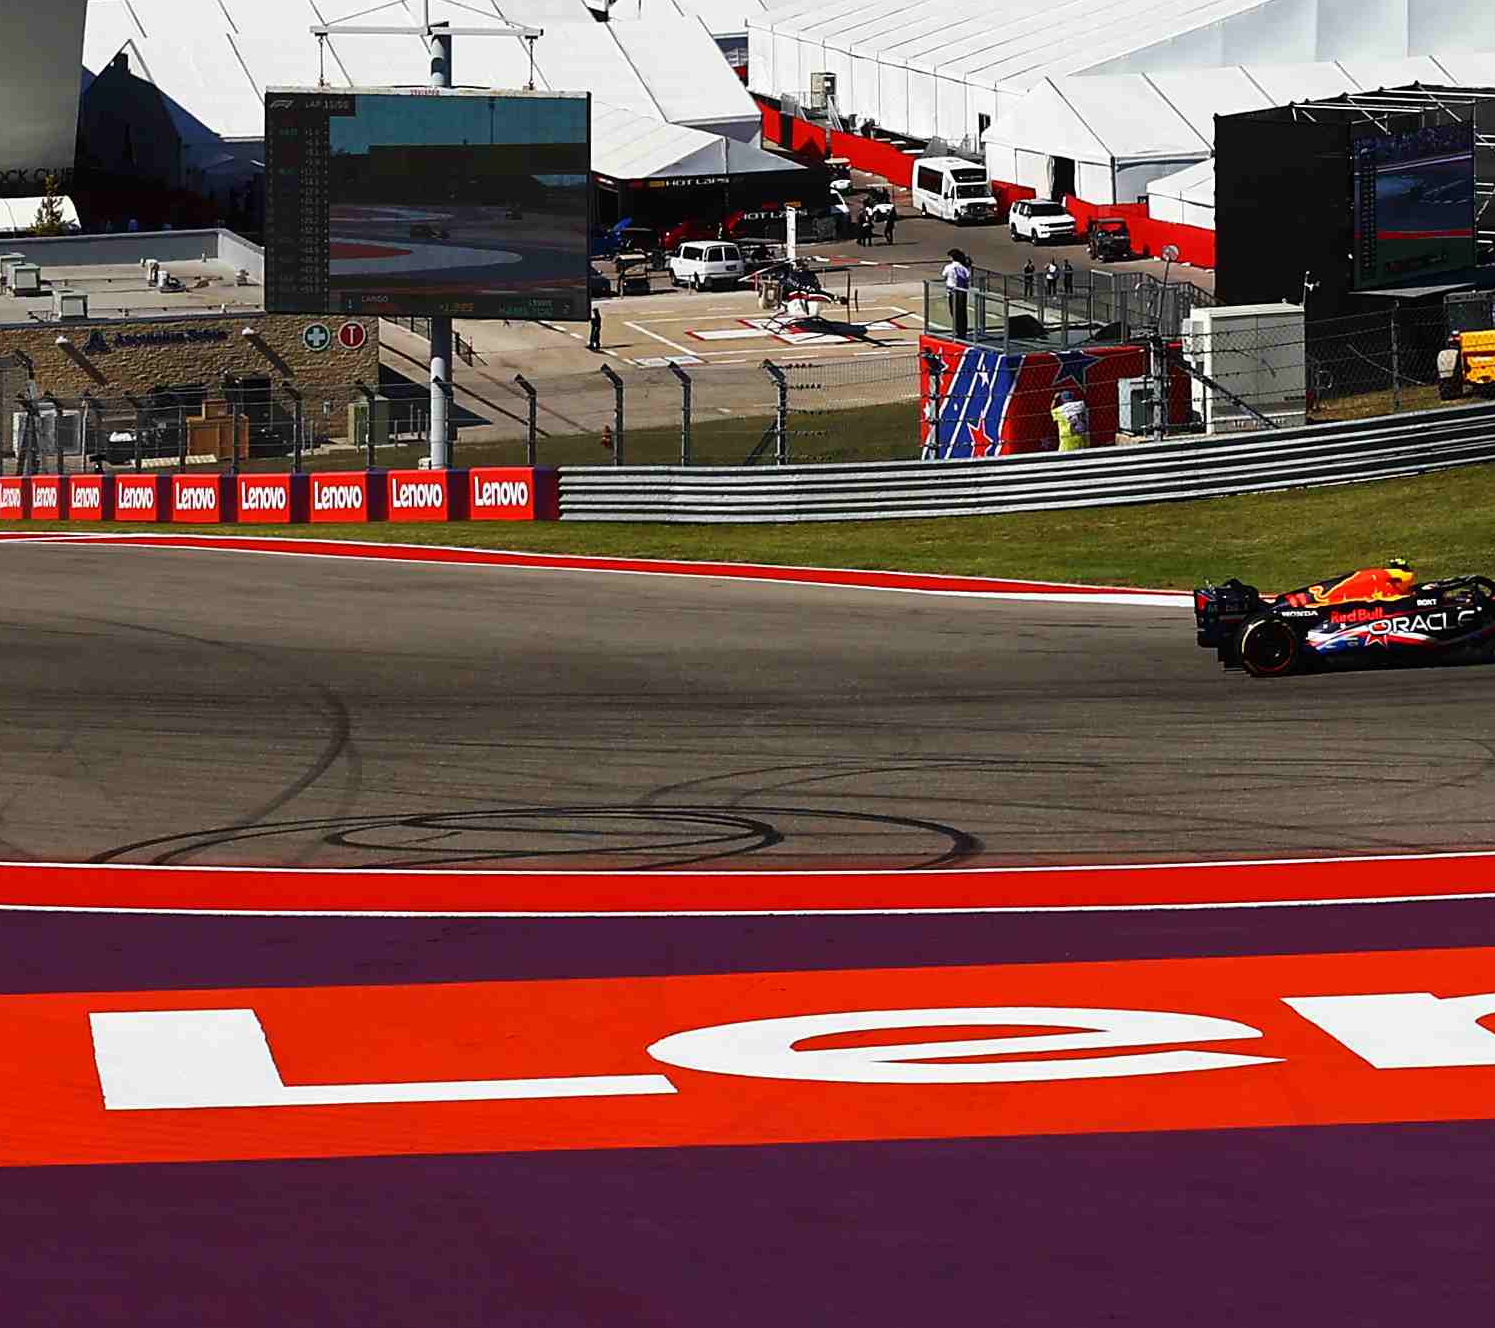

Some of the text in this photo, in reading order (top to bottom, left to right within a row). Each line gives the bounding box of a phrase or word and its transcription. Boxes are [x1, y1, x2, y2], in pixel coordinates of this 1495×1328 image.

[0, 483, 21, 508] Lenovo
[32, 483, 56, 508] Lenovo
[72, 482, 99, 508] Lenovo
[119, 483, 153, 509] Lenovo
[176, 483, 215, 510] Lenovo
[242, 482, 286, 510] Lenovo
[315, 481, 362, 509] Lenovo
[393, 479, 442, 508] Lenovo
[474, 477, 528, 507] Lenovo
[1330, 607, 1383, 624] Red Bull
[1369, 610, 1474, 635] ORACLE
